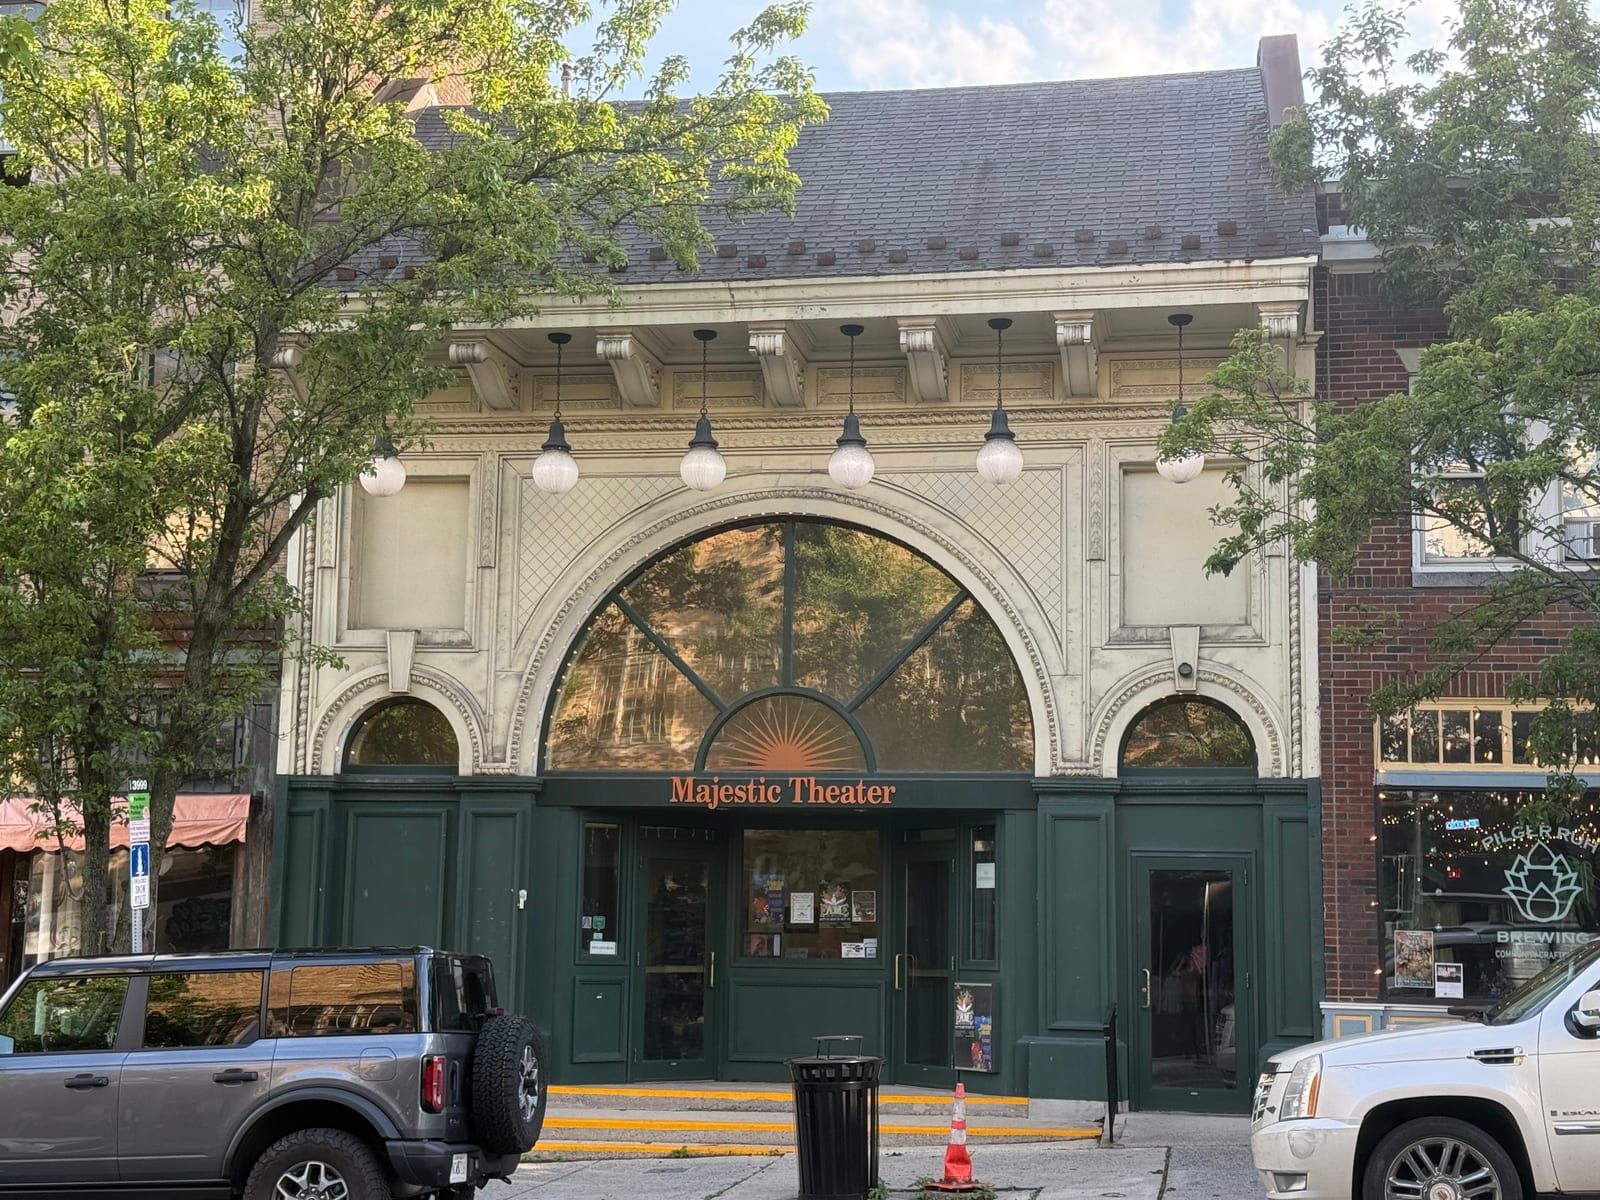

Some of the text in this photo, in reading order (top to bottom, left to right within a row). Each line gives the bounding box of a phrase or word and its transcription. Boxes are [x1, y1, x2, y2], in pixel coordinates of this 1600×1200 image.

[669, 776, 896, 809] Majestic Theater
[1480, 824, 1552, 851] PILGER
[1556, 827, 1599, 854] RUH
[1496, 931, 1589, 943] BREWING
